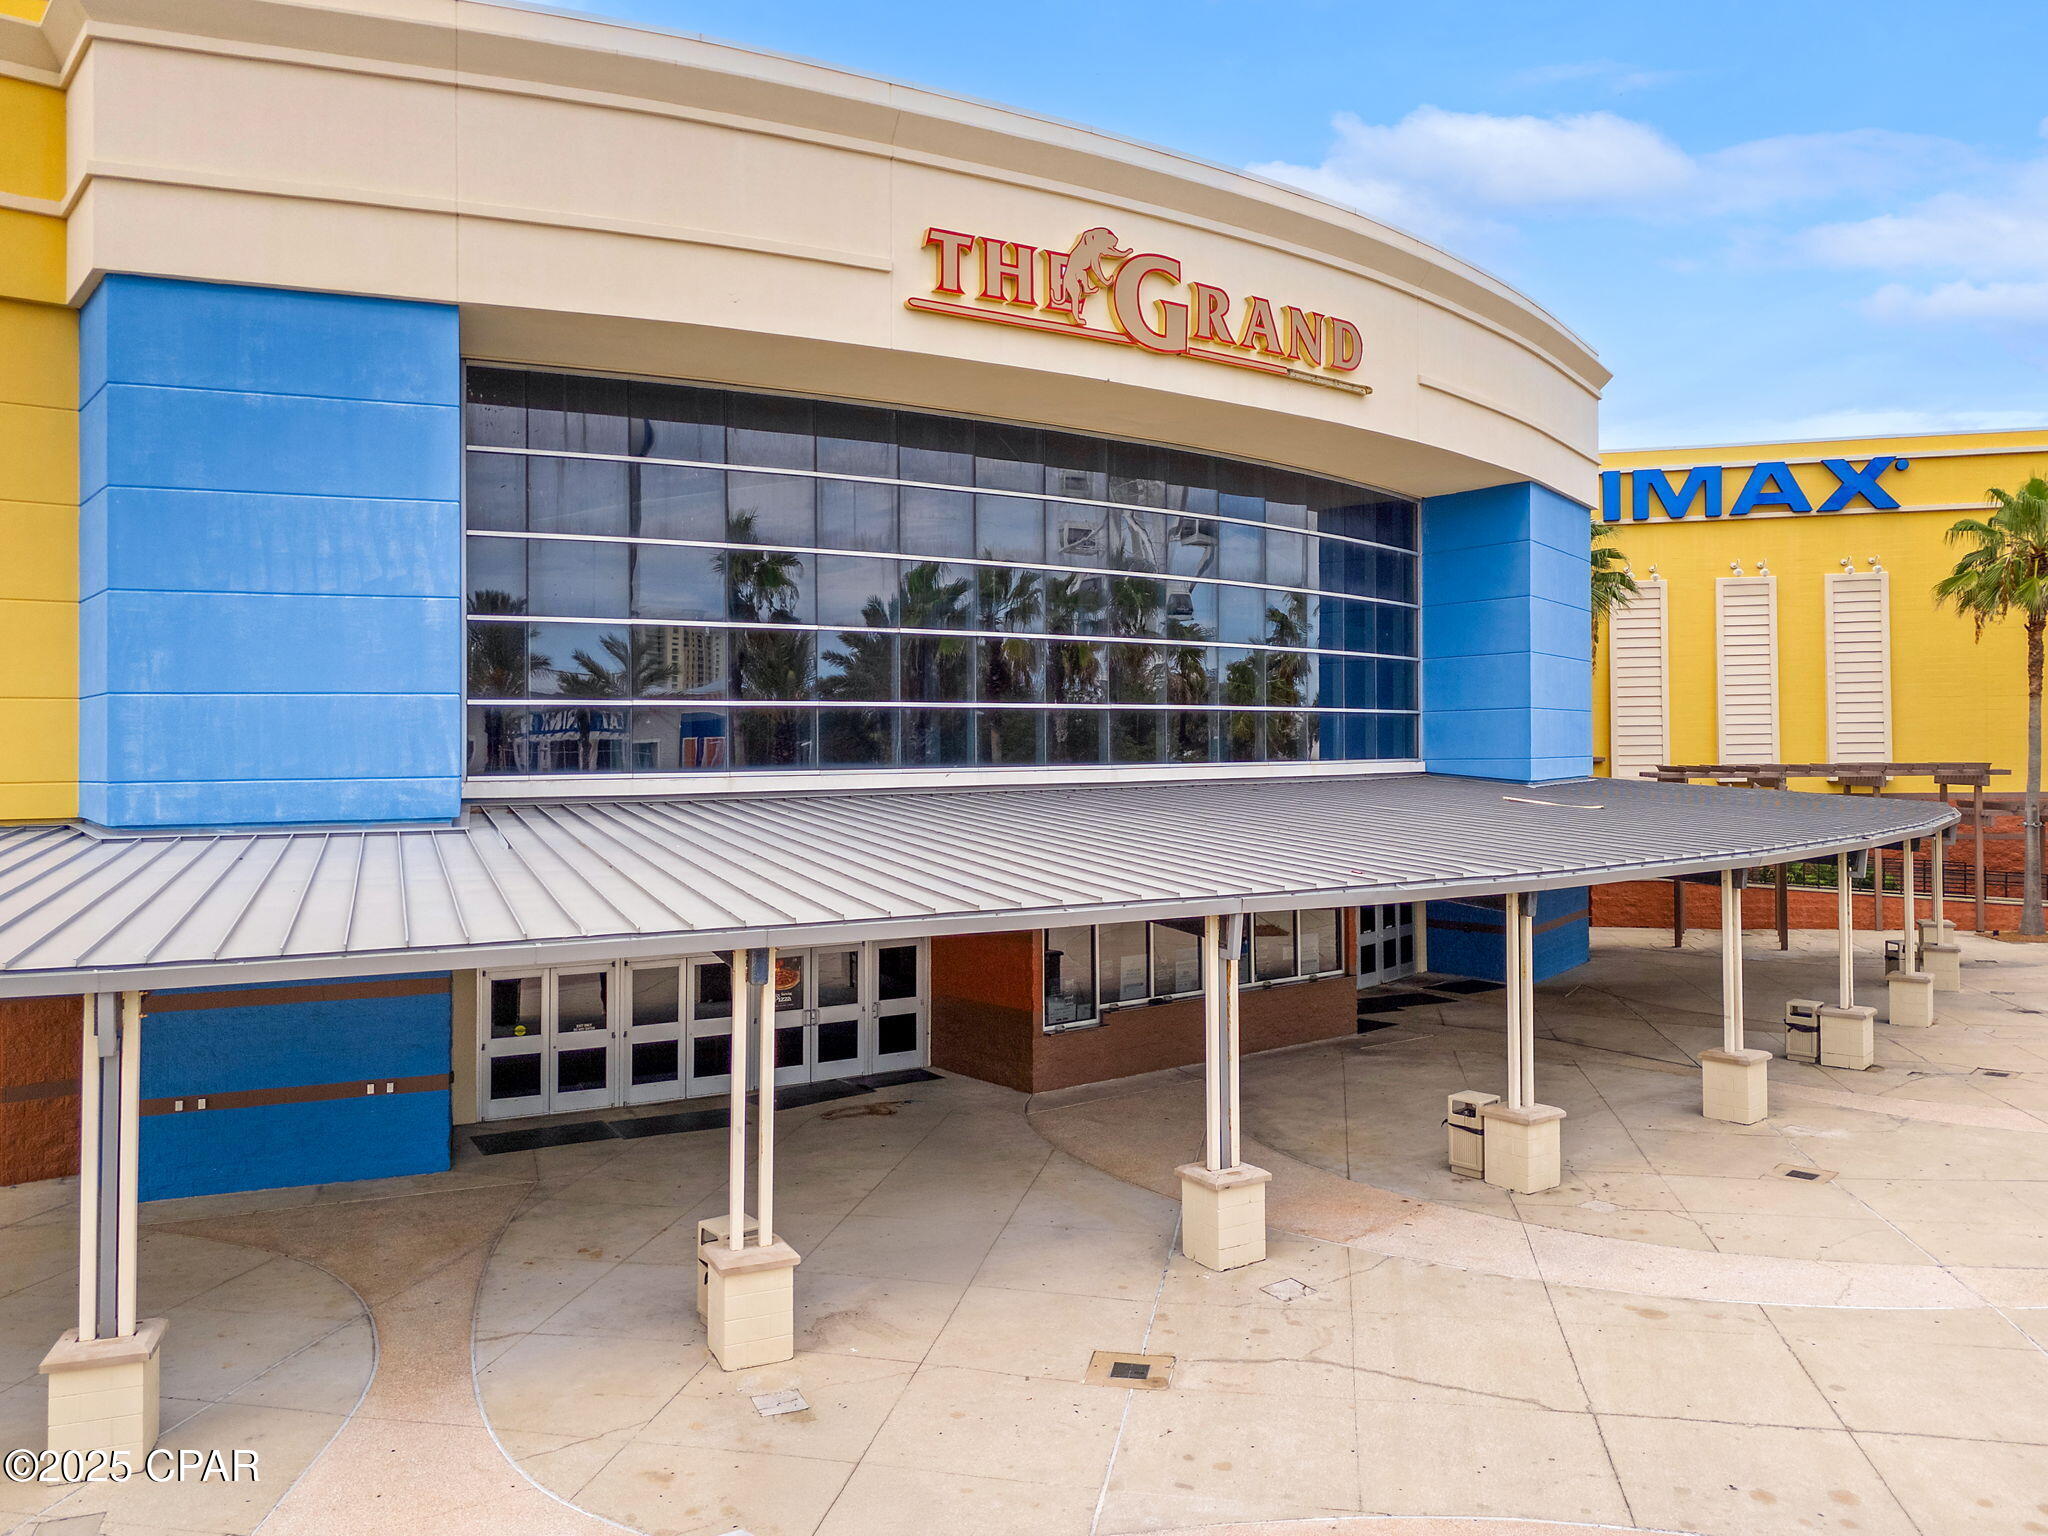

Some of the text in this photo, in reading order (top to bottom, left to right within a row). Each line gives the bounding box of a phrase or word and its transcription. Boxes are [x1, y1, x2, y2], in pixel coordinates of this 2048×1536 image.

[922, 227, 1364, 372] THE GRAND
[1602, 456, 1902, 523] IMAX
